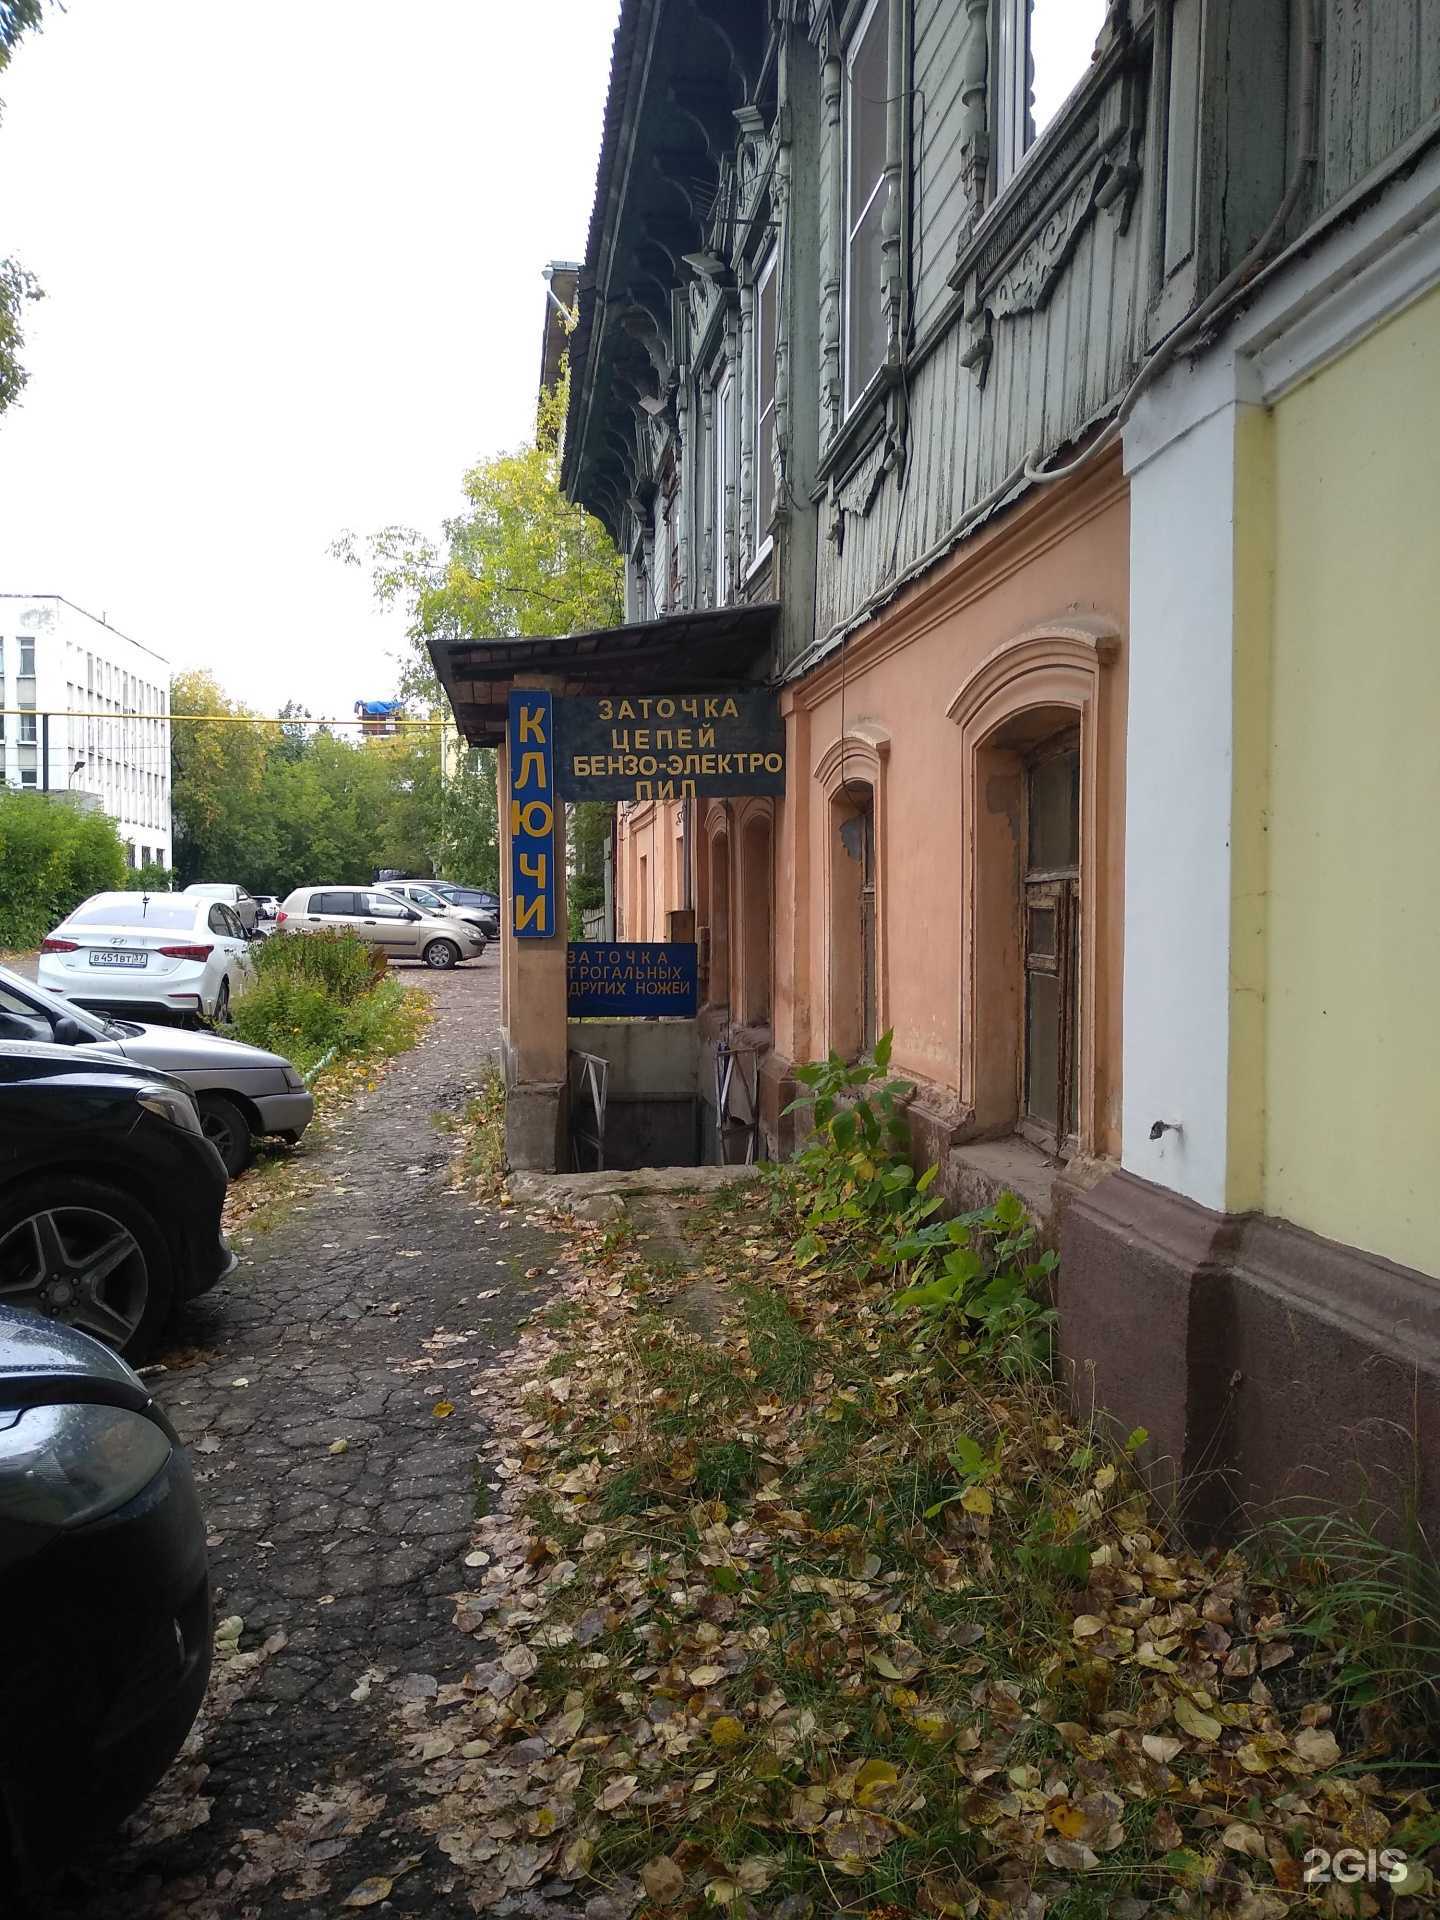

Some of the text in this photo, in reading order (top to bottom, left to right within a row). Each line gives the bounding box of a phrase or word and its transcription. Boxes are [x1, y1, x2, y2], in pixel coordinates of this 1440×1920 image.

[598, 698, 739, 720] ЗАТОЧКА
[611, 722, 716, 752] ЦЕПЕЙ
[573, 753, 783, 777] БЕНЗО-ЭЛЕКТРО
[635, 779, 697, 800] ПИЛ
[512, 706, 554, 932] КЛЮЧИ
[568, 950, 669, 965] ЗАТОЧКА
[567, 966, 682, 980] ТРОГАЛЬНЫХ
[569, 981, 627, 998] ДРУГИХ
